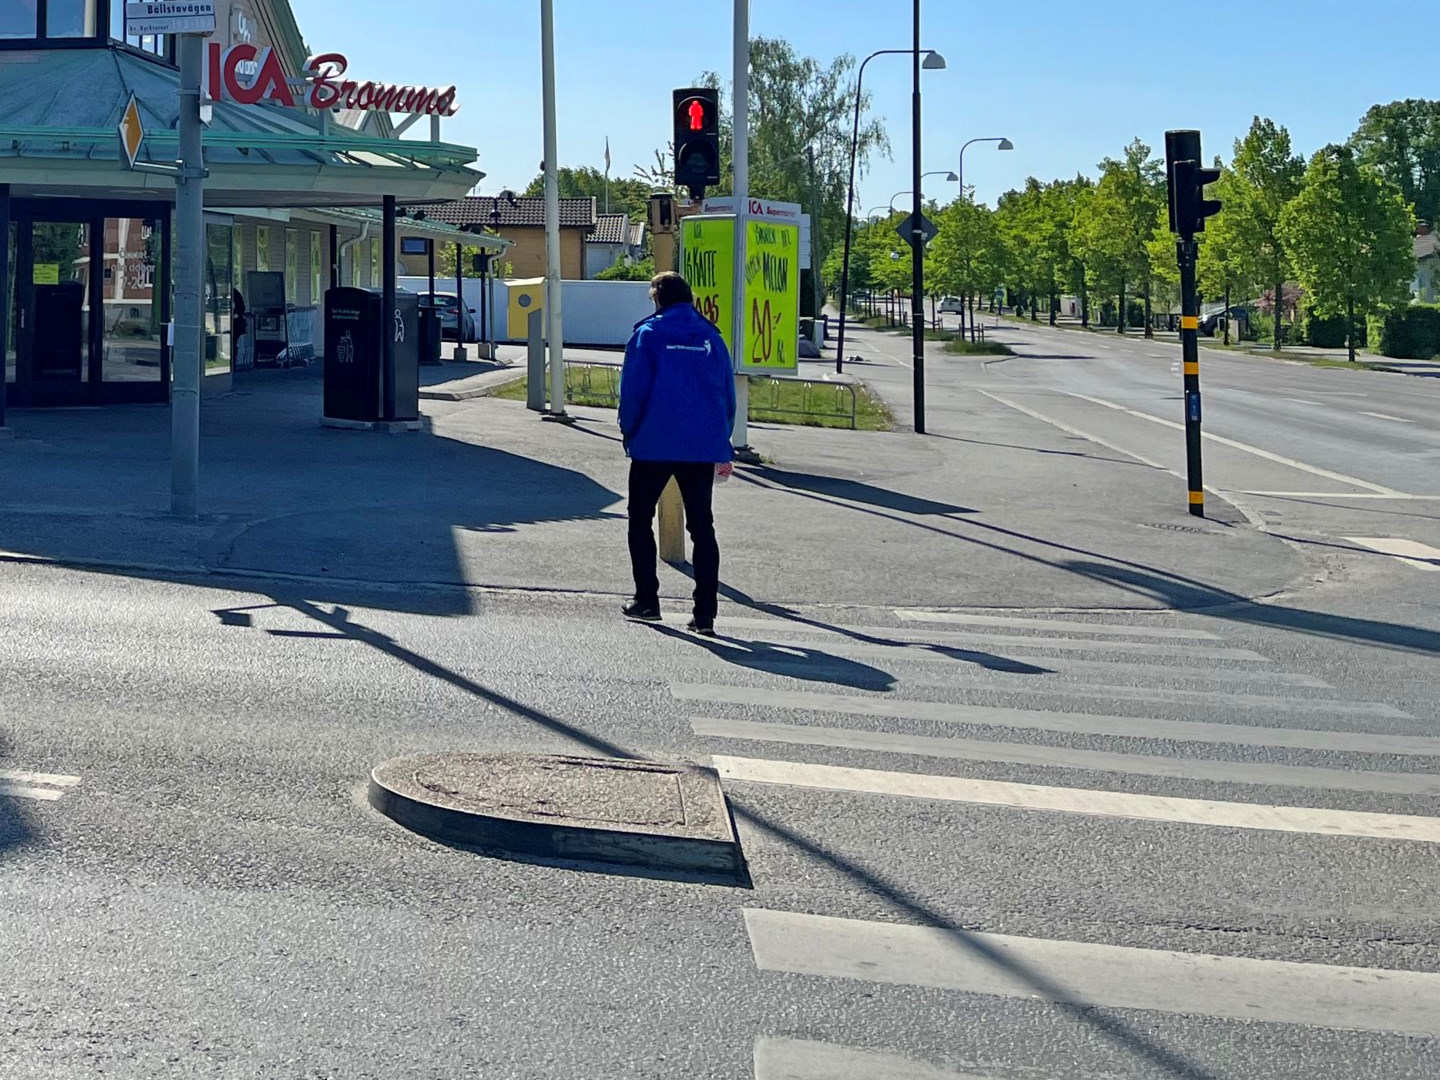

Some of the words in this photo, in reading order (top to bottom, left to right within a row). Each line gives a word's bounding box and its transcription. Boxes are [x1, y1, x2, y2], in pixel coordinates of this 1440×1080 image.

[147, 4, 211, 14] Bällstavägen
[207, 42, 295, 106] ICA
[305, 52, 460, 117] Bromma
[748, 199, 764, 215] ICA
